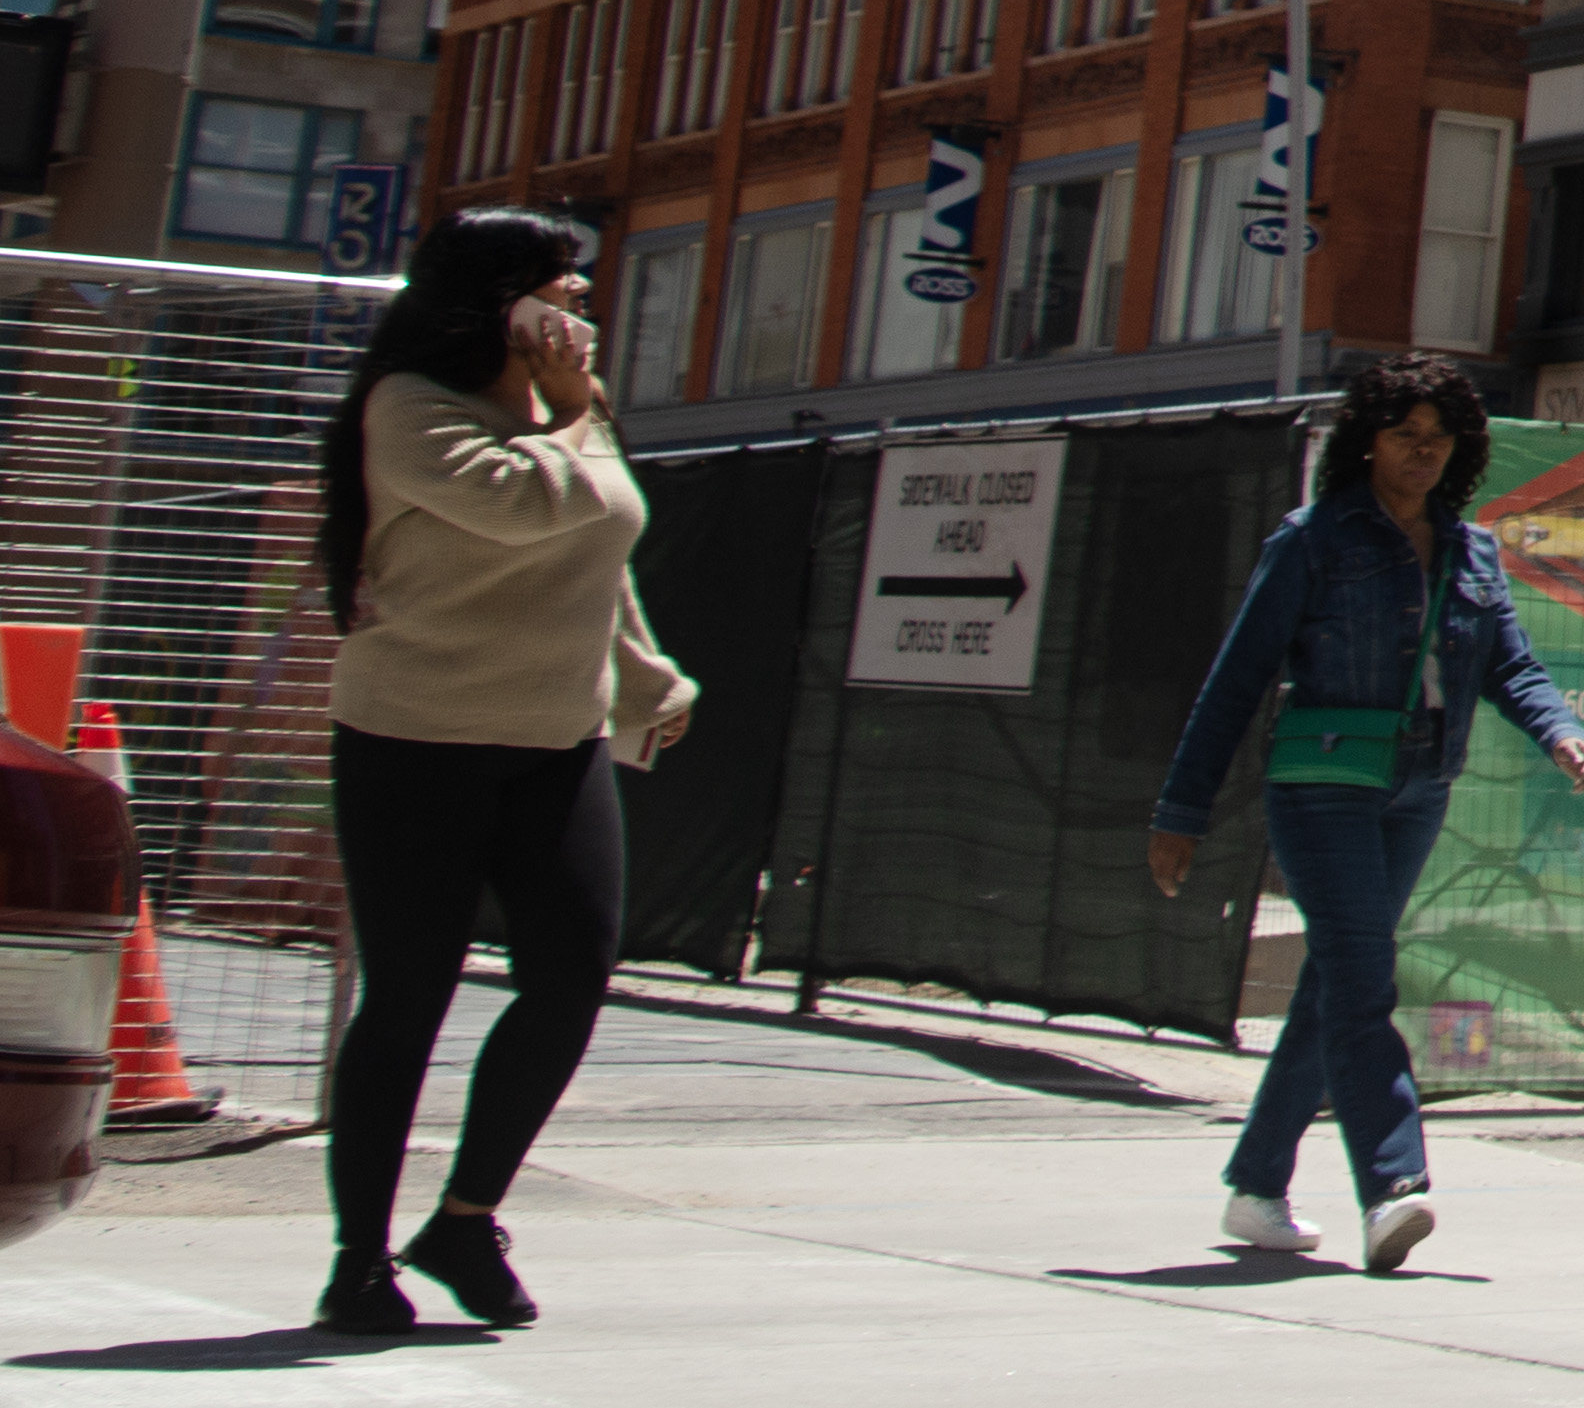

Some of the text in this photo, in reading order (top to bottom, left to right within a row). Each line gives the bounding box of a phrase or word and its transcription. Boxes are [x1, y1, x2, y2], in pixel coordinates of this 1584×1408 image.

[912, 274, 969, 297] ROSS
[899, 469, 1038, 507] SIDEWALK CLOSED
[933, 519, 987, 553] AHEAD
[895, 619, 995, 655] CROSS HERE
